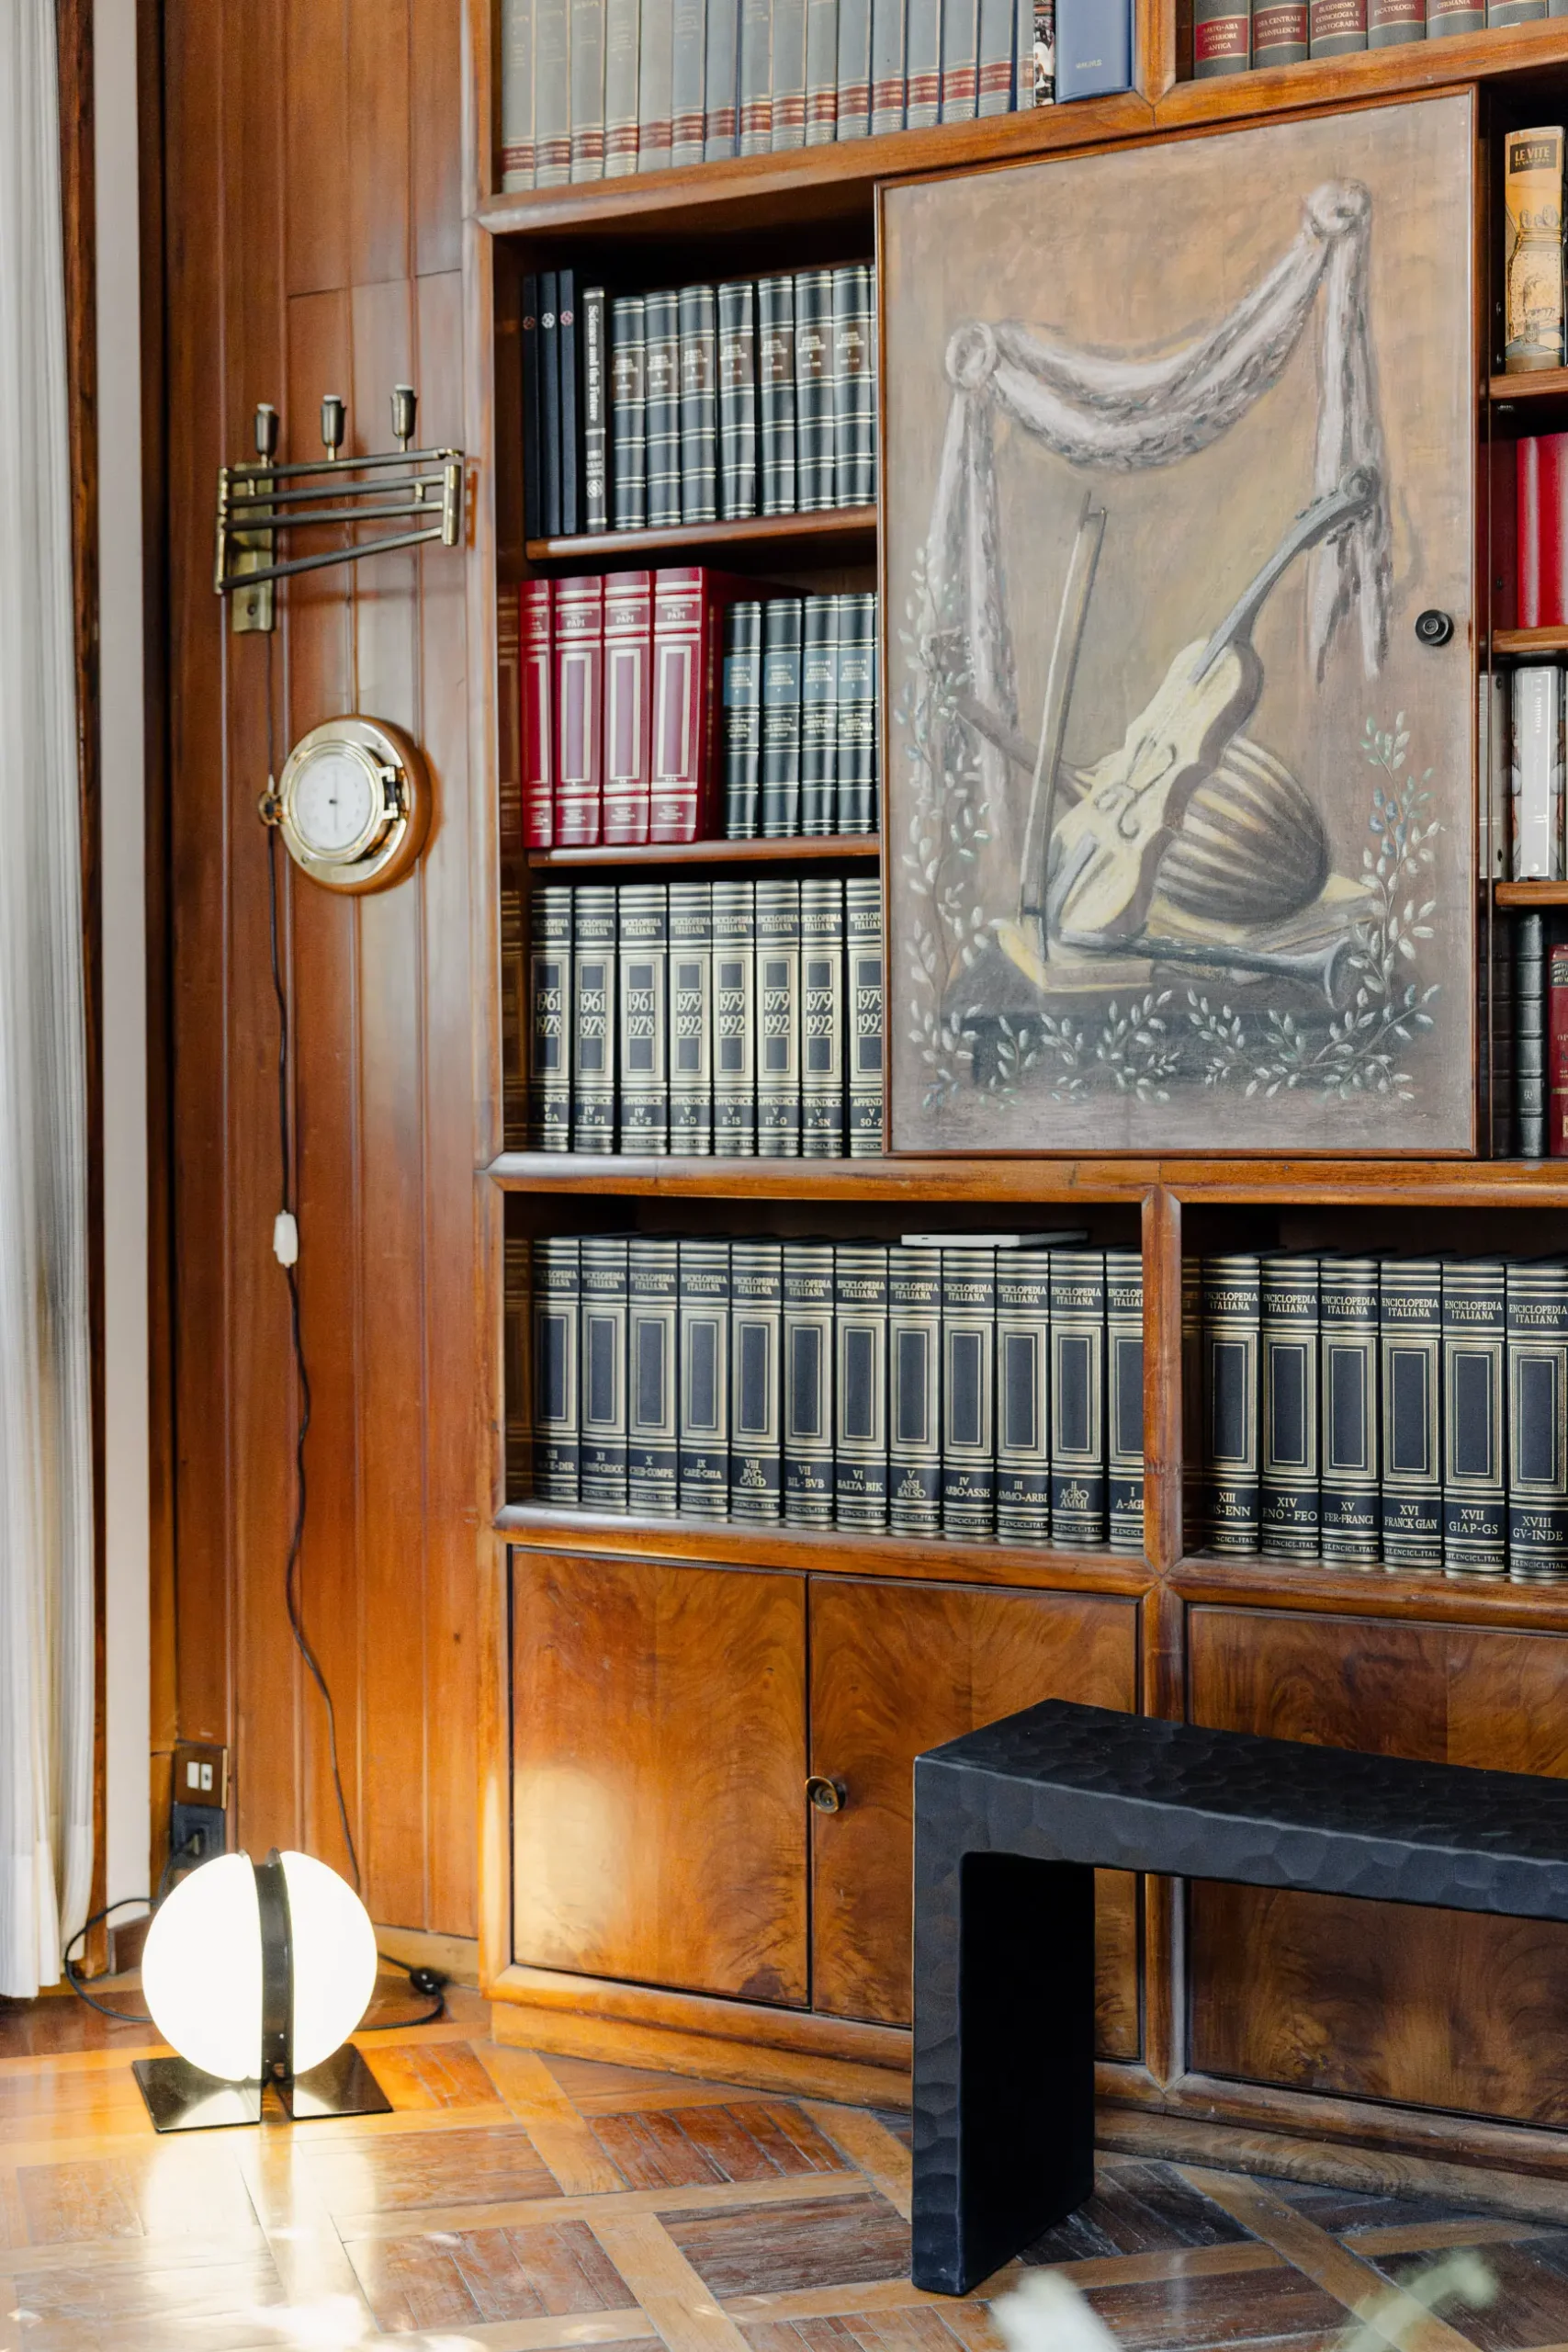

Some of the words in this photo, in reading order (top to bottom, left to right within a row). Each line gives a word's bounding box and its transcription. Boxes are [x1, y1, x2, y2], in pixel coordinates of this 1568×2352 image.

[1516, 150, 1525, 162] LE
[1527, 147, 1551, 159] VITE
[588, 305, 599, 345] Science
[580, 990, 606, 1012] 1961
[627, 991, 654, 1012] 1961
[676, 991, 702, 1012] 1979
[719, 991, 744, 1011] 1979
[764, 991, 790, 1011] 1979
[807, 991, 833, 1011] 1979
[579, 1016, 606, 1035] 1978
[627, 1015, 654, 1035] 1978
[676, 1015, 702, 1035] 1992
[719, 1015, 744, 1035] 1992
[764, 1015, 790, 1035] 1992
[807, 1015, 833, 1035] 1992
[584, 1106, 594, 1114] IV
[683, 1107, 691, 1115] V
[728, 1107, 735, 1115] V
[773, 1107, 779, 1115] V
[816, 1108, 821, 1116] V
[869, 1108, 875, 1117] V
[838, 1280, 885, 1290] ENCICLOPEDIA
[891, 1282, 939, 1292] ENCICLOPEDIA
[944, 1283, 992, 1294] ENCICLOPEDIA
[998, 1284, 1046, 1295] ENCICLOPEDIA
[842, 1288, 878, 1298] ITALIANA
[896, 1291, 931, 1300] ITALIANA
[948, 1293, 985, 1301] ITALIANA
[1052, 1287, 1100, 1297] ENCICLOPEDIA
[1003, 1294, 1038, 1304] ITALIANA
[1056, 1295, 1093, 1306] ITALIANA
[1263, 1294, 1316, 1304] ENCICLOPEDIA
[1322, 1295, 1376, 1306] ENCICLOPEDIA
[1382, 1298, 1438, 1308] ENCICLOPEDIA
[1269, 1304, 1308, 1313] ITALIANA
[1328, 1306, 1368, 1315] ITALIANA
[1444, 1301, 1503, 1311] ENCICLOPEDIA
[1509, 1305, 1567, 1315] ENCICLOPEDIA
[1389, 1307, 1430, 1317] ITALIANA
[1451, 1310, 1494, 1319] ITALIANA
[1516, 1314, 1559, 1324] ITALIANA
[646, 1455, 653, 1464] X
[798, 1465, 810, 1476] VII
[853, 1470, 863, 1479] VI
[908, 1470, 915, 1479] V
[739, 1477, 766, 1487] CARD
[959, 1477, 970, 1487] IV
[1014, 1481, 1023, 1490] III
[1071, 1481, 1077, 1489] II
[897, 1488, 926, 1498] BALSO
[998, 1490, 1047, 1503] AMMO-ARBI
[1060, 1489, 1089, 1499] AGRO
[1130, 1487, 1135, 1497] I
[1219, 1492, 1236, 1503] XIII
[1060, 1499, 1088, 1510] AMMI
[1277, 1498, 1297, 1508] XIV
[1341, 1501, 1355, 1511] XV
[1211, 1505, 1250, 1516] IS-ENN
[1400, 1505, 1418, 1515] XVI
[1461, 1510, 1484, 1520] XVII
[1325, 1512, 1374, 1524] FER-FRANCI
[1385, 1517, 1414, 1529] FRANCK
[1416, 1520, 1437, 1529] GIAN
[1522, 1516, 1551, 1527] XVIII
[1450, 1521, 1498, 1534] GIAP-GS
[1514, 1528, 1563, 1541] GV-INDE
